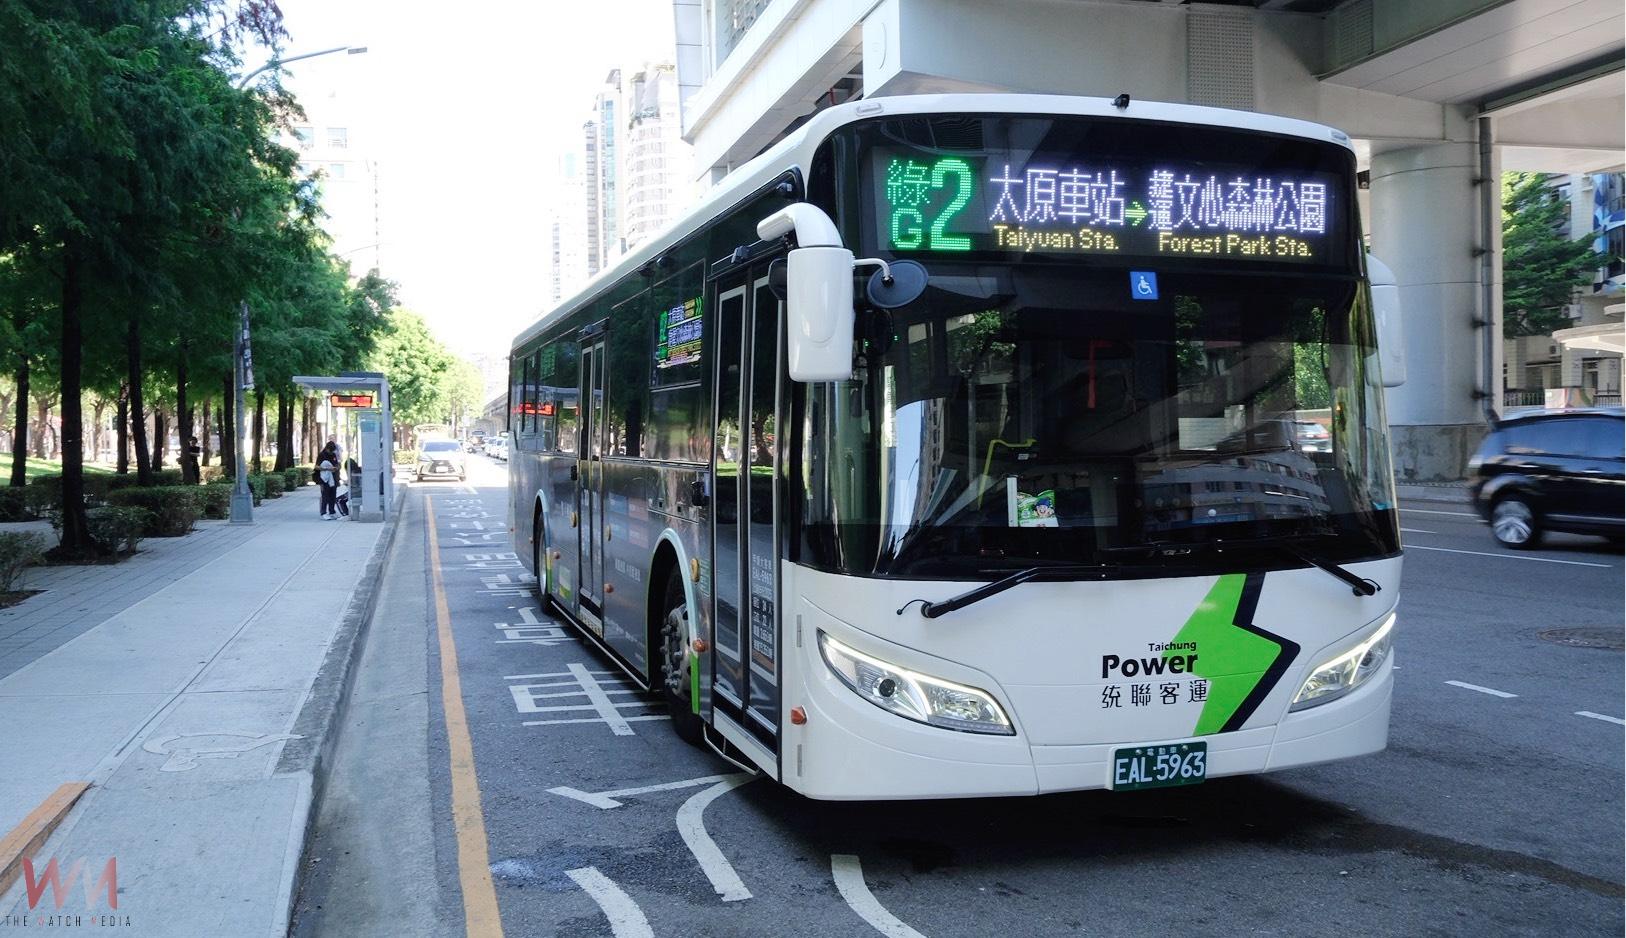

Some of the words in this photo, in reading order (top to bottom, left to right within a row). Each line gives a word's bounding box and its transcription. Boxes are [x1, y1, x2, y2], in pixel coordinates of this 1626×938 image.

[989, 164, 1125, 226] 太原車站
[993, 225, 1074, 252] Taiyuan
[1079, 228, 1119, 250] Sta.
[1159, 231, 1222, 254] Forest
[1226, 234, 1271, 255] Park
[1275, 236, 1312, 257] Sta.
[1148, 641, 1197, 652] Taichung
[1101, 654, 1199, 679] Power
[1101, 679, 1208, 709] 統聯客運
